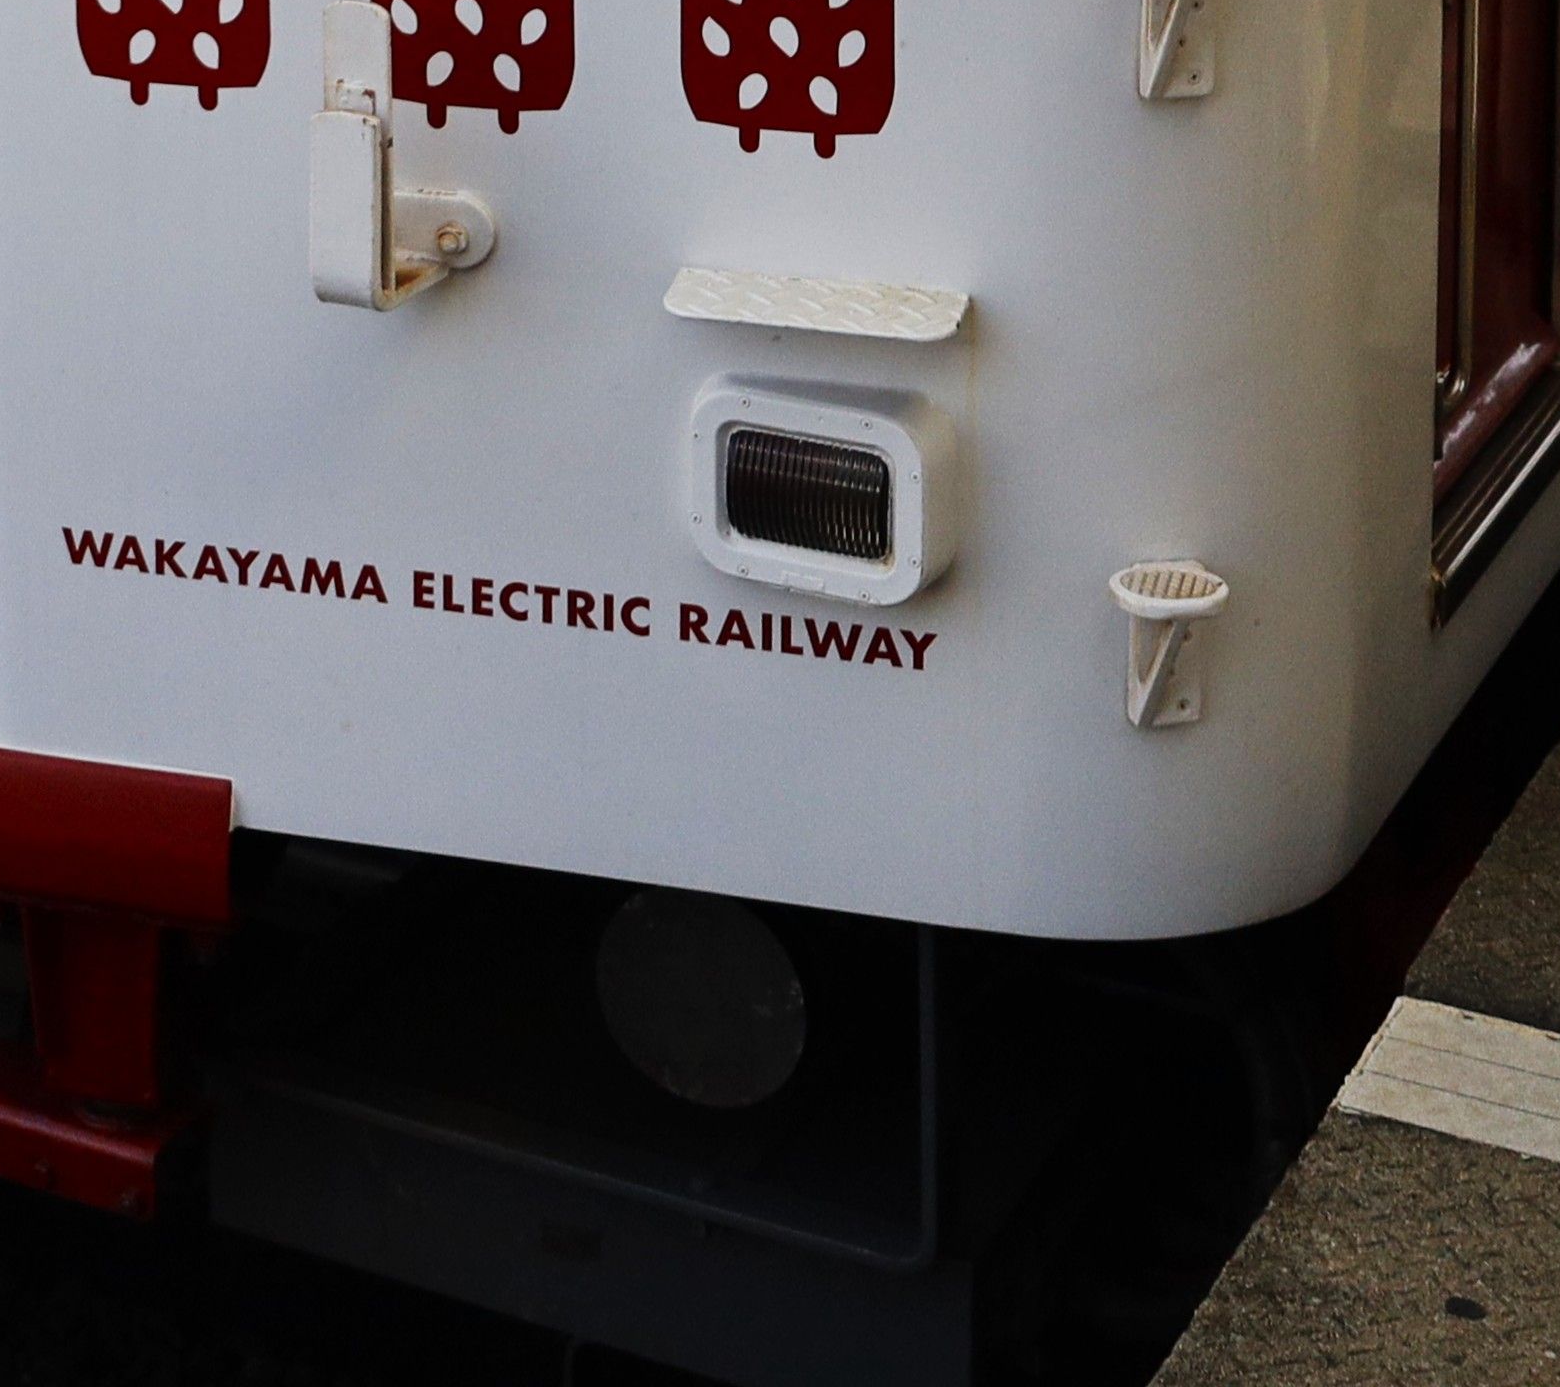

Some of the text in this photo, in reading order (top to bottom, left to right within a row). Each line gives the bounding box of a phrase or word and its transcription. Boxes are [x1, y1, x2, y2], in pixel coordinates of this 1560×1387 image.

[61, 525, 939, 672] WAKAYAMA ELECTRIC RAILWAY
